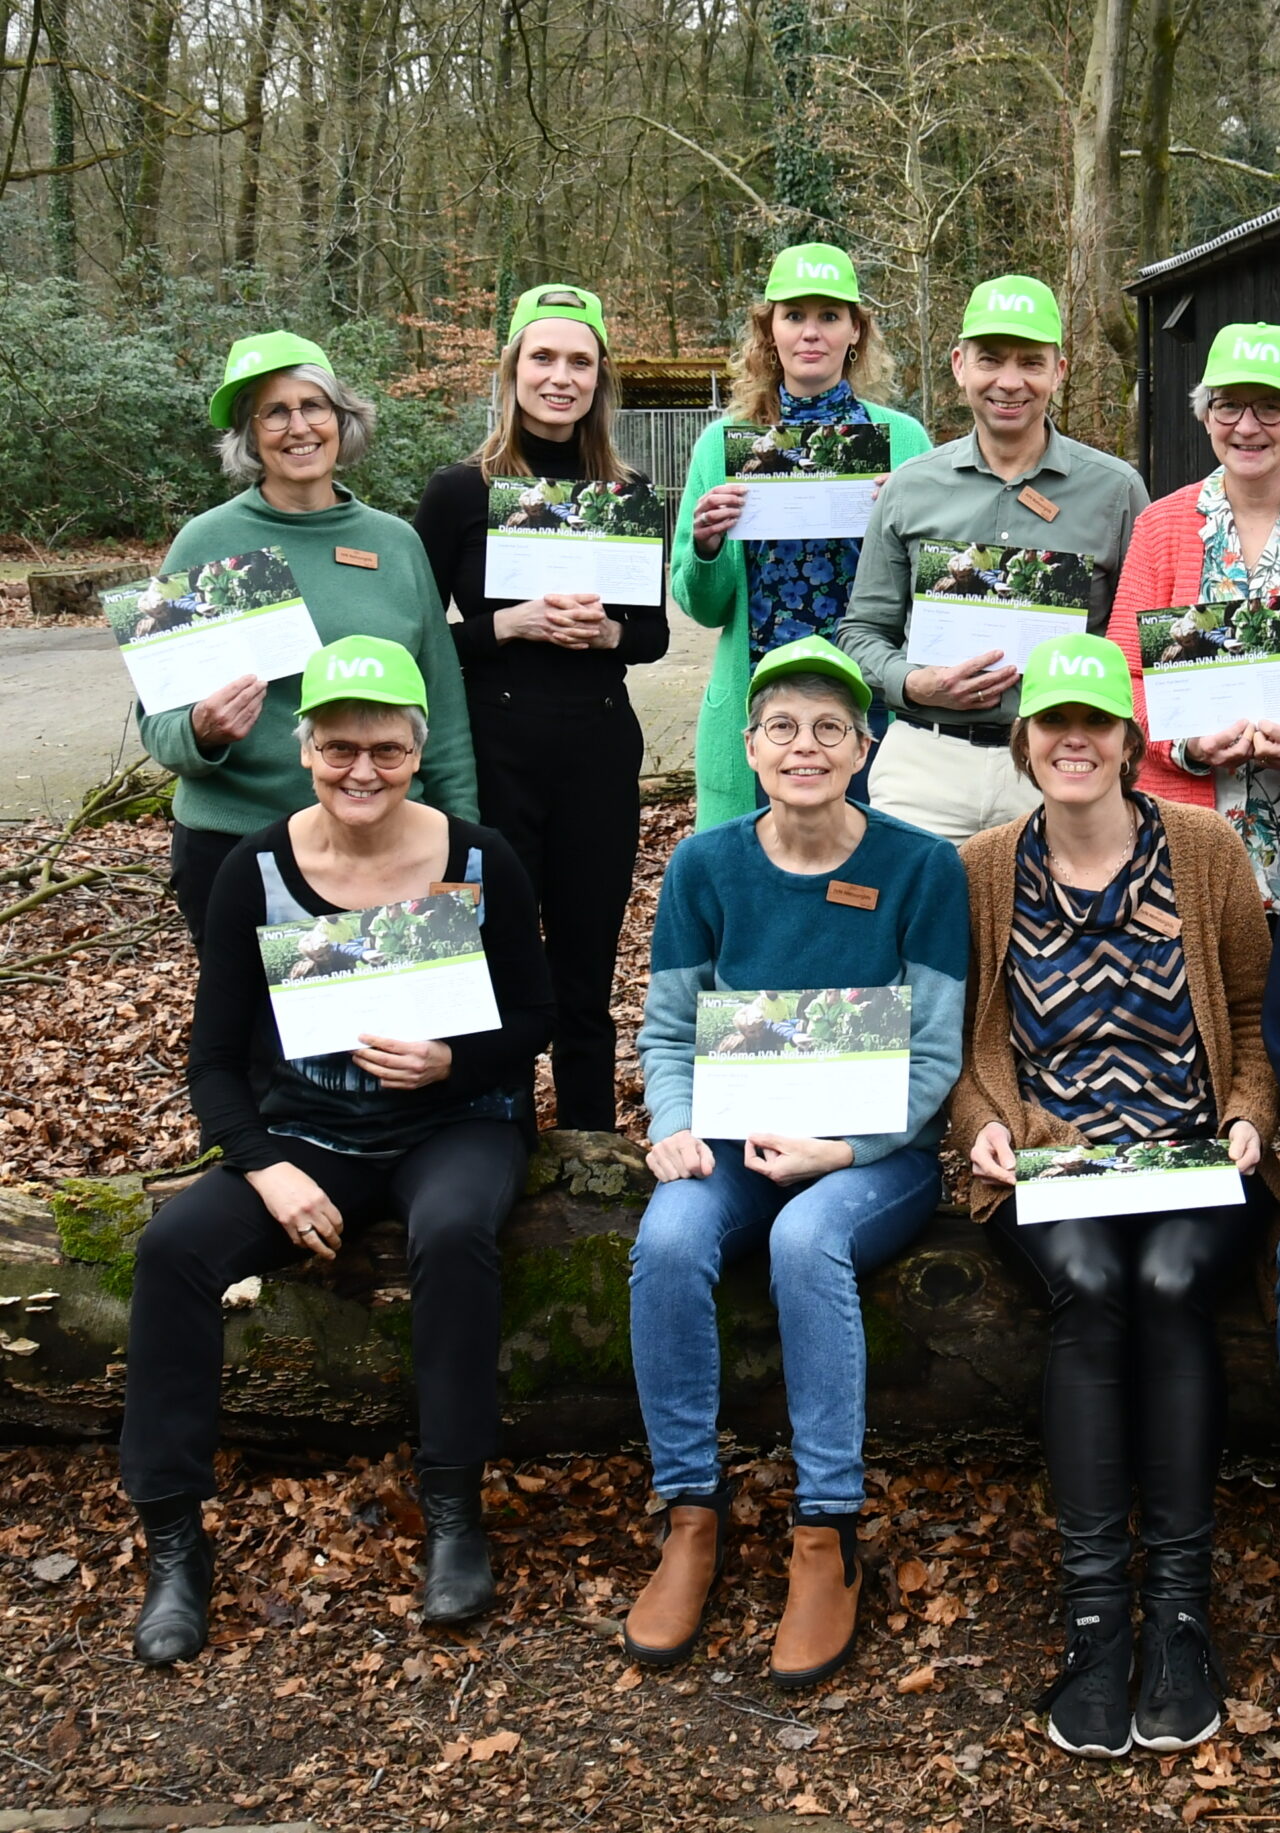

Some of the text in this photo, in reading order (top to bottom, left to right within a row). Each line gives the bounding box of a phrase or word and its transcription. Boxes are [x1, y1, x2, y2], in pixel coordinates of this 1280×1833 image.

[795, 256, 841, 282] ivn
[987, 288, 1035, 314] ivn
[1232, 335, 1280, 364] ivn
[735, 472, 772, 482] Diploma
[498, 526, 537, 535] Diploma
[925, 590, 964, 601] Diploma
[327, 655, 384, 682] ivn
[1048, 649, 1105, 680] ivn
[1153, 658, 1194, 671] Diploma
